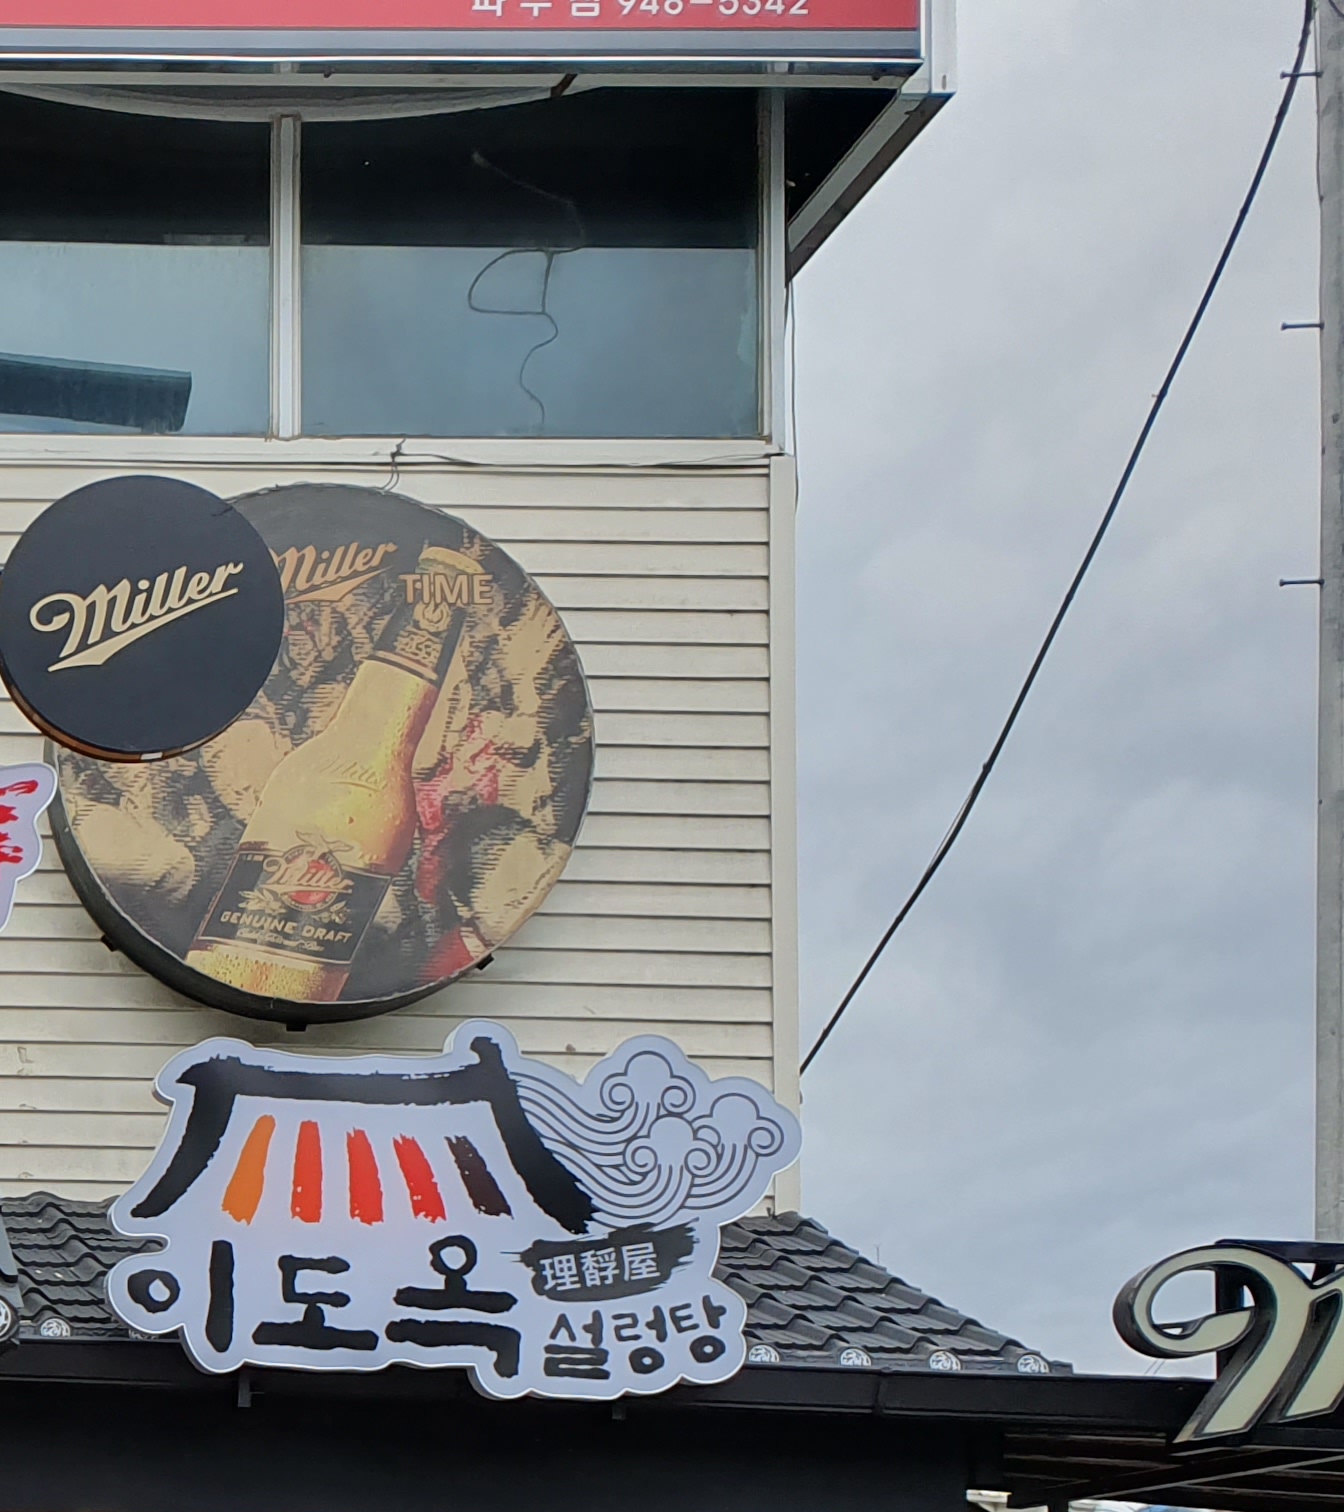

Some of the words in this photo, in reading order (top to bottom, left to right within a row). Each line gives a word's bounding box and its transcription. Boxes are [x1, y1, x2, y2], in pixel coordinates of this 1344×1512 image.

[29, 559, 243, 673] Miller
[399, 573, 493, 605] TIME
[262, 856, 355, 895] Miller
[220, 910, 298, 935] GENUINE
[301, 924, 353, 943] DRAFT
[127, 1234, 519, 1378] 이도옥
[543, 1295, 726, 1380] 설렁탕
